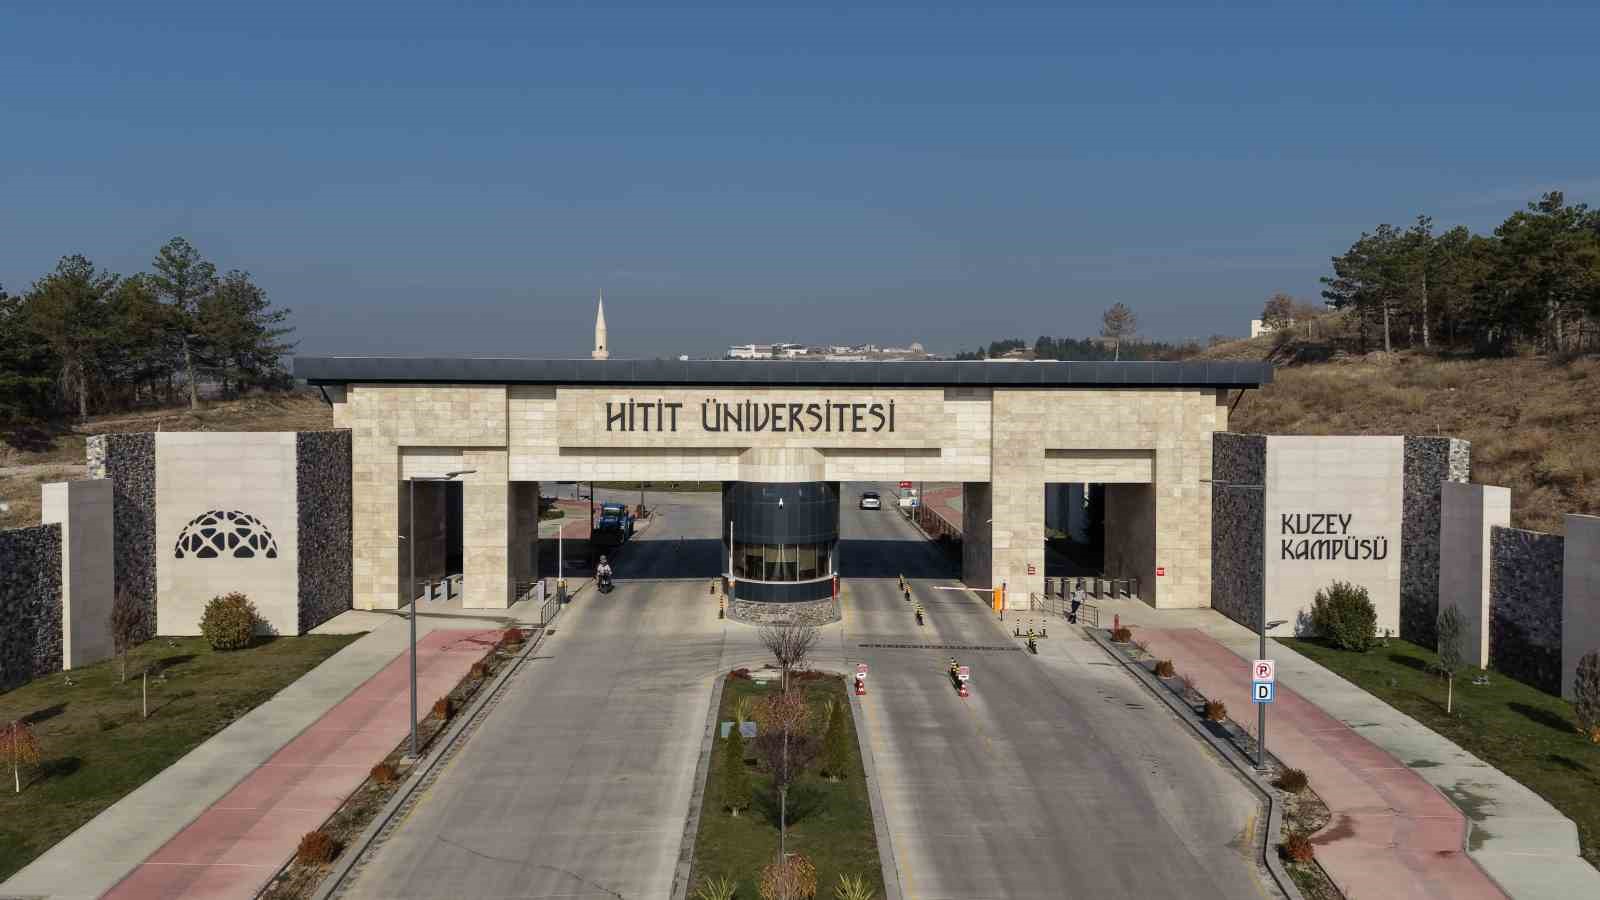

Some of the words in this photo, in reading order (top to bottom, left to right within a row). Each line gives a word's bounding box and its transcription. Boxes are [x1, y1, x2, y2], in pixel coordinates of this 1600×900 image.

[606, 398, 683, 432] HİTİT
[702, 398, 895, 432] ÜNİVERSİTESİ
[1281, 513, 1352, 535] KUZEY
[1281, 536, 1388, 560] KAMPÜSÜ
[1259, 685, 1268, 698] D
